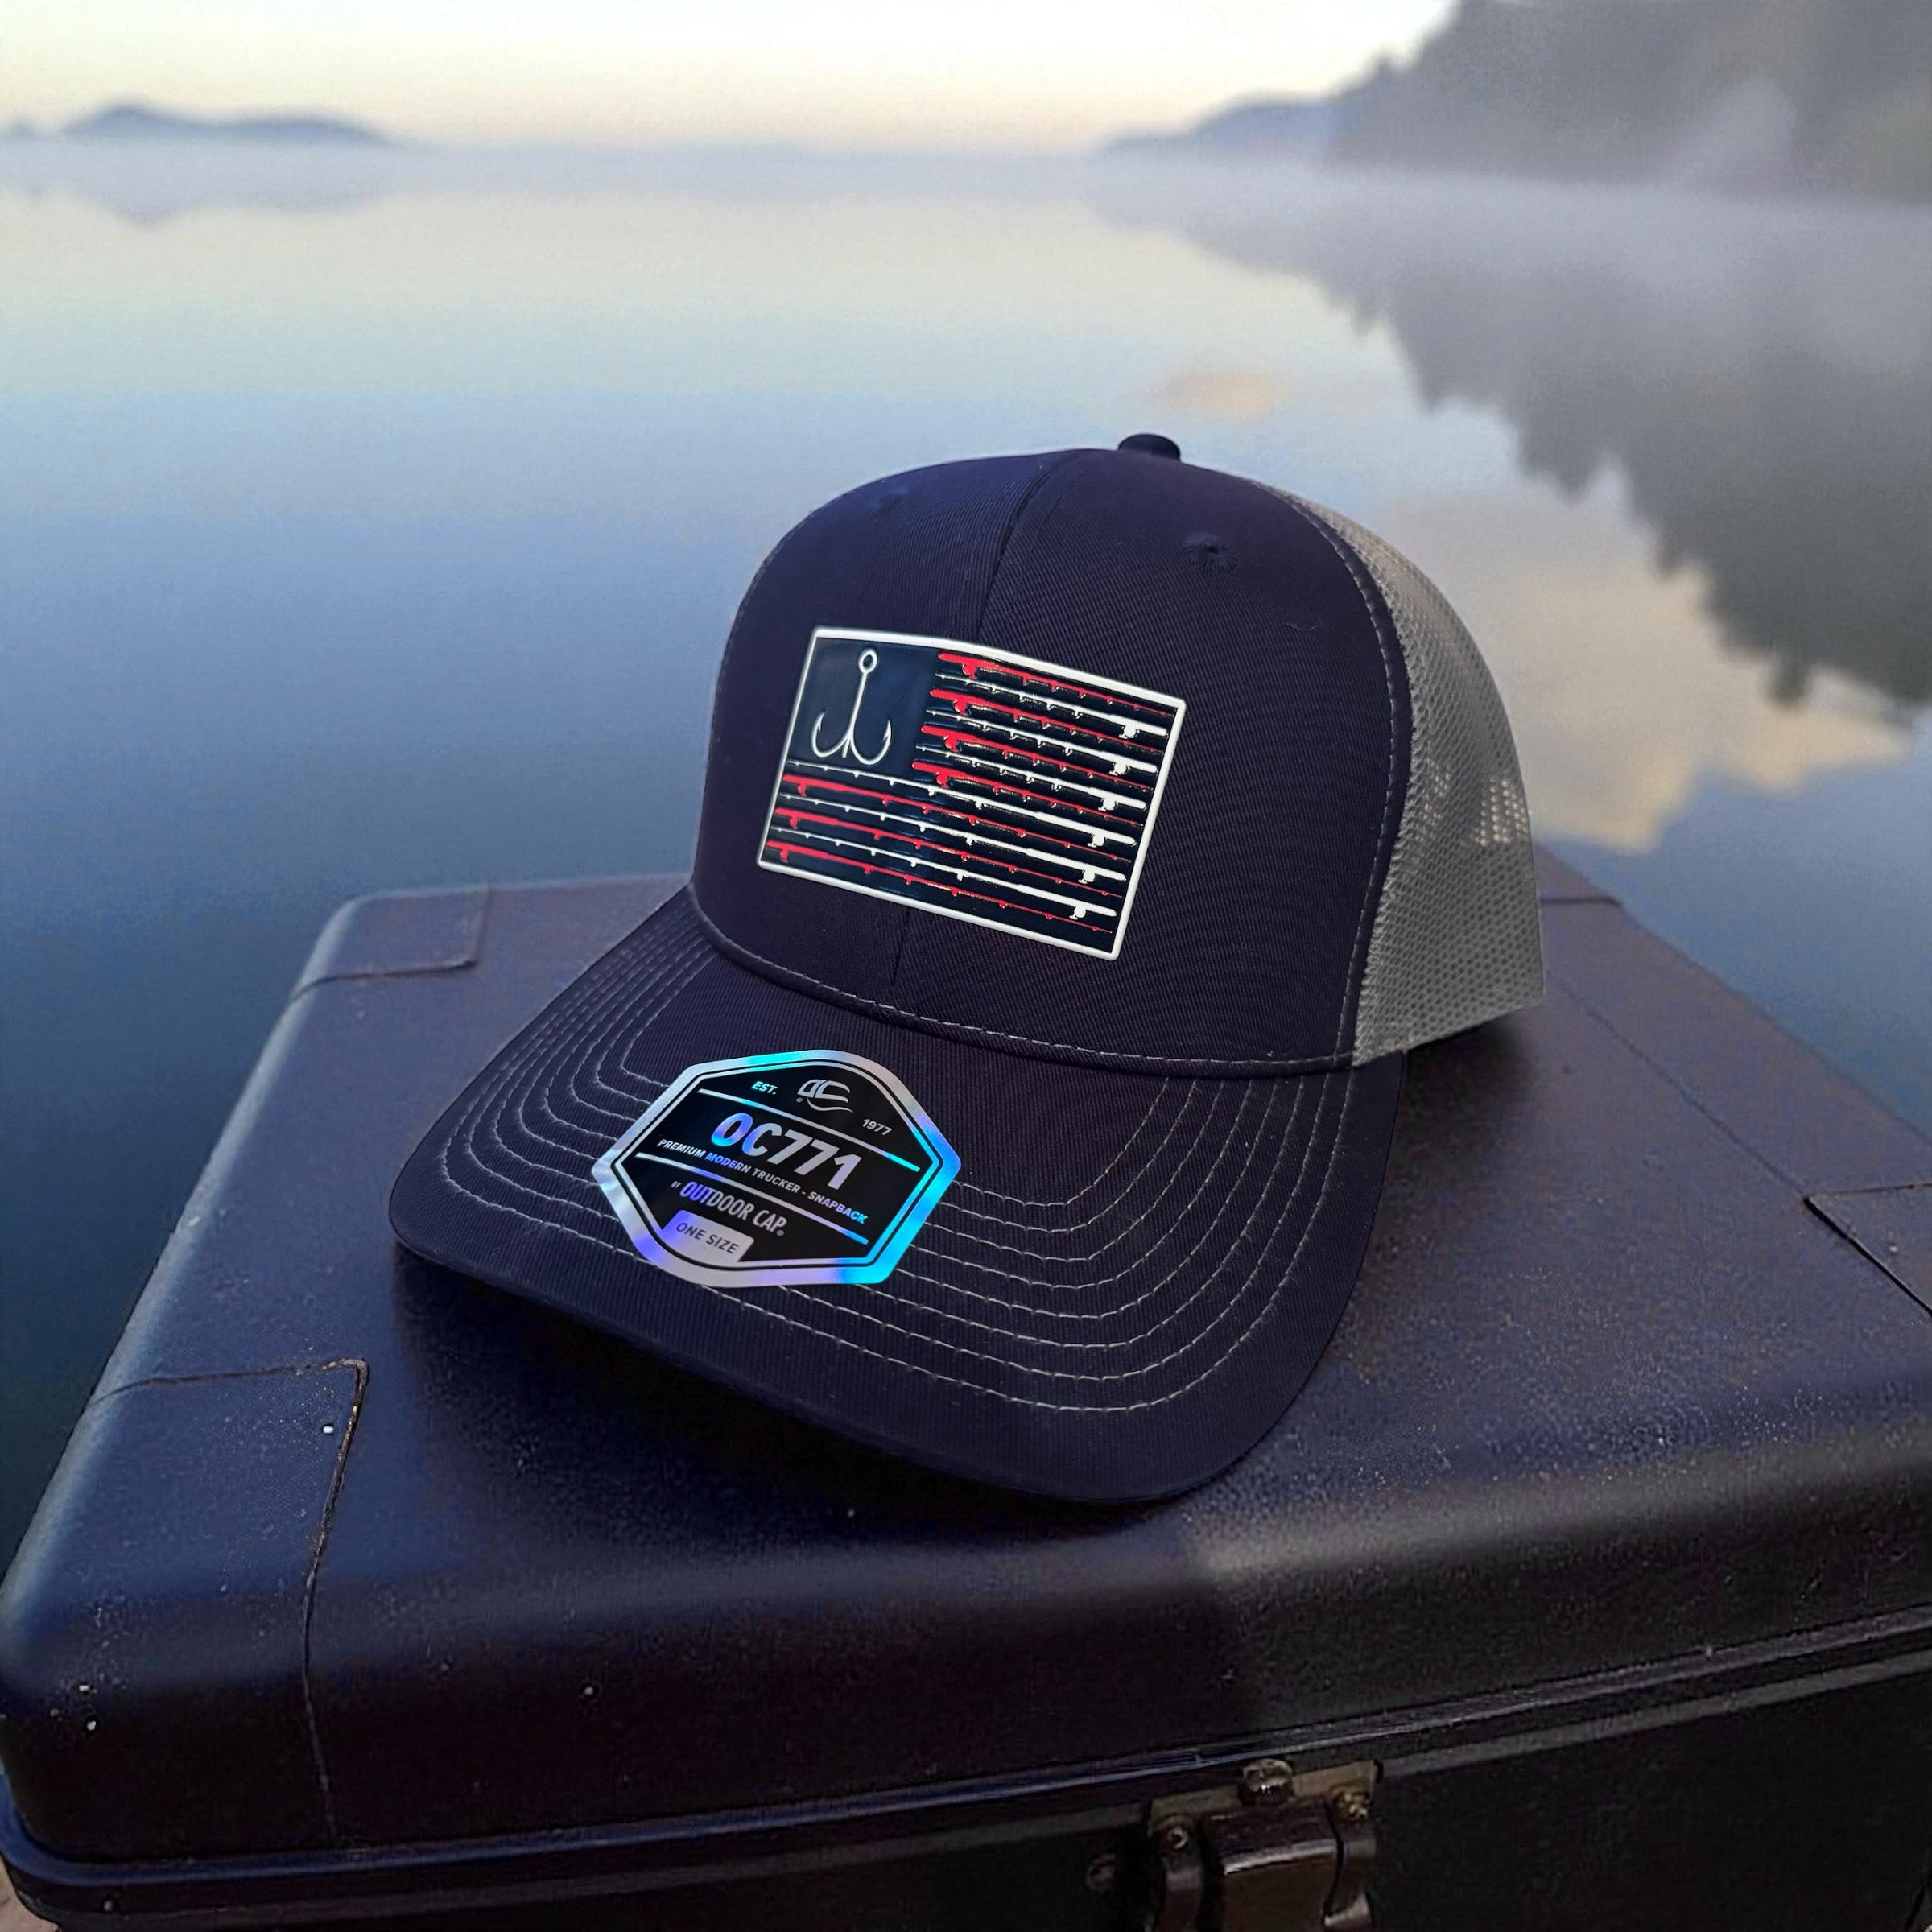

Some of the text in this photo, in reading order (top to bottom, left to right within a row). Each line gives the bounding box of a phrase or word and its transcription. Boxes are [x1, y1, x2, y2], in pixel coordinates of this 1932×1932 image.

[751, 1081, 778, 1095] EST.
[862, 1119, 893, 1136] 1977
[711, 1113, 862, 1190] OC771
[657, 1139, 706, 1158] PREMIUM
[705, 1152, 752, 1174] MODERN
[752, 1167, 801, 1193] TRUCKER
[807, 1191, 868, 1224] SNAPBACK
[679, 1181, 755, 1220] OUTDOOR
[676, 1223, 739, 1253] ONE SIZE
